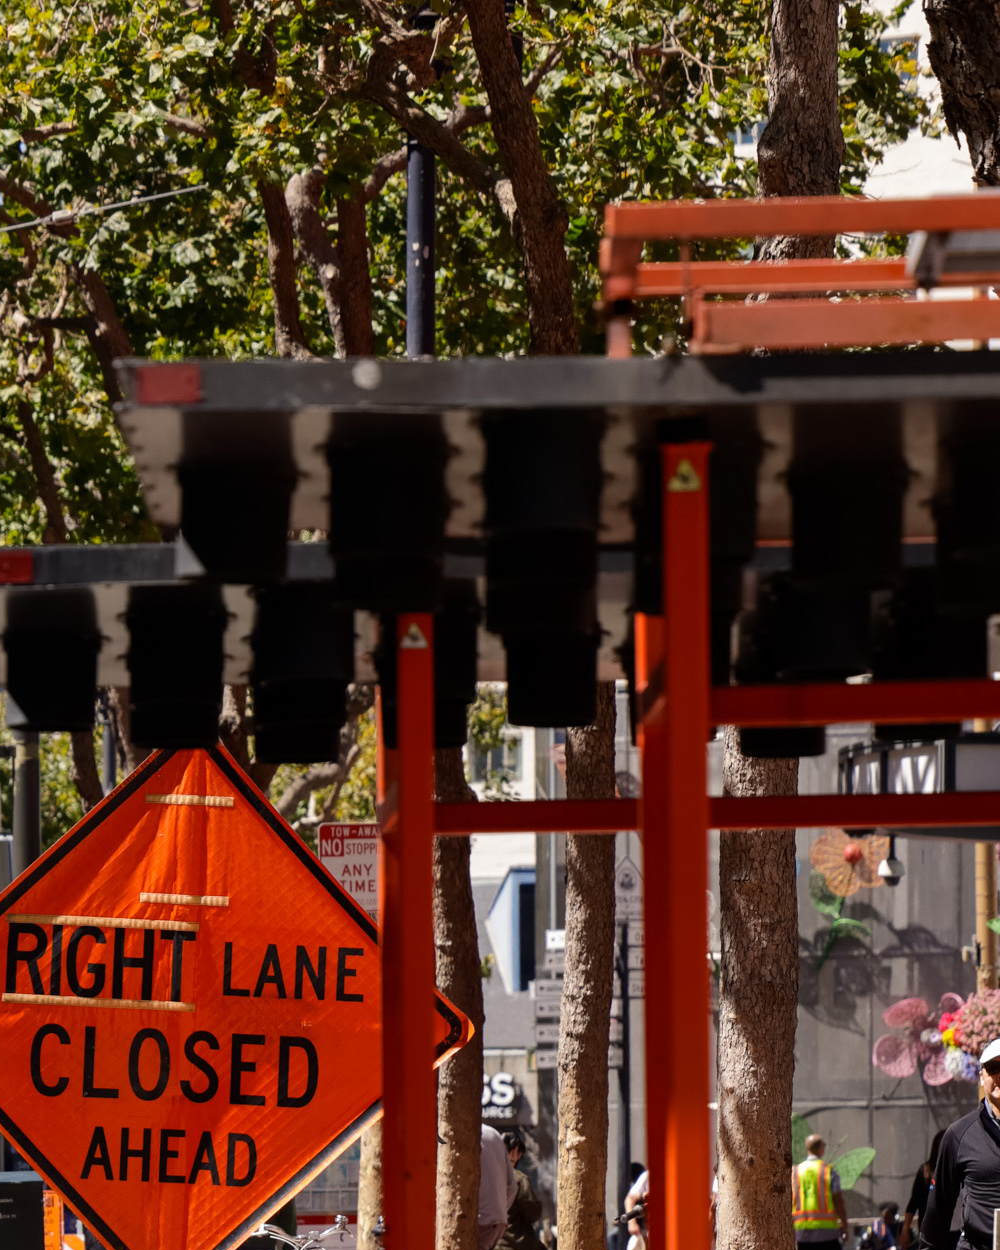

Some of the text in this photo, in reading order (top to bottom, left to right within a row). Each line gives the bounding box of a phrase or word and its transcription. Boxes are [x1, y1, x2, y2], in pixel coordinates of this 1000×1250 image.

[321, 838, 379, 856] NO STOPPI
[341, 863, 373, 877] ANY
[341, 879, 377, 893] TIME
[5, 923, 364, 1003] RIGHT LANE
[29, 1023, 320, 1108] CLOSED
[81, 1127, 256, 1186] AHEAD
